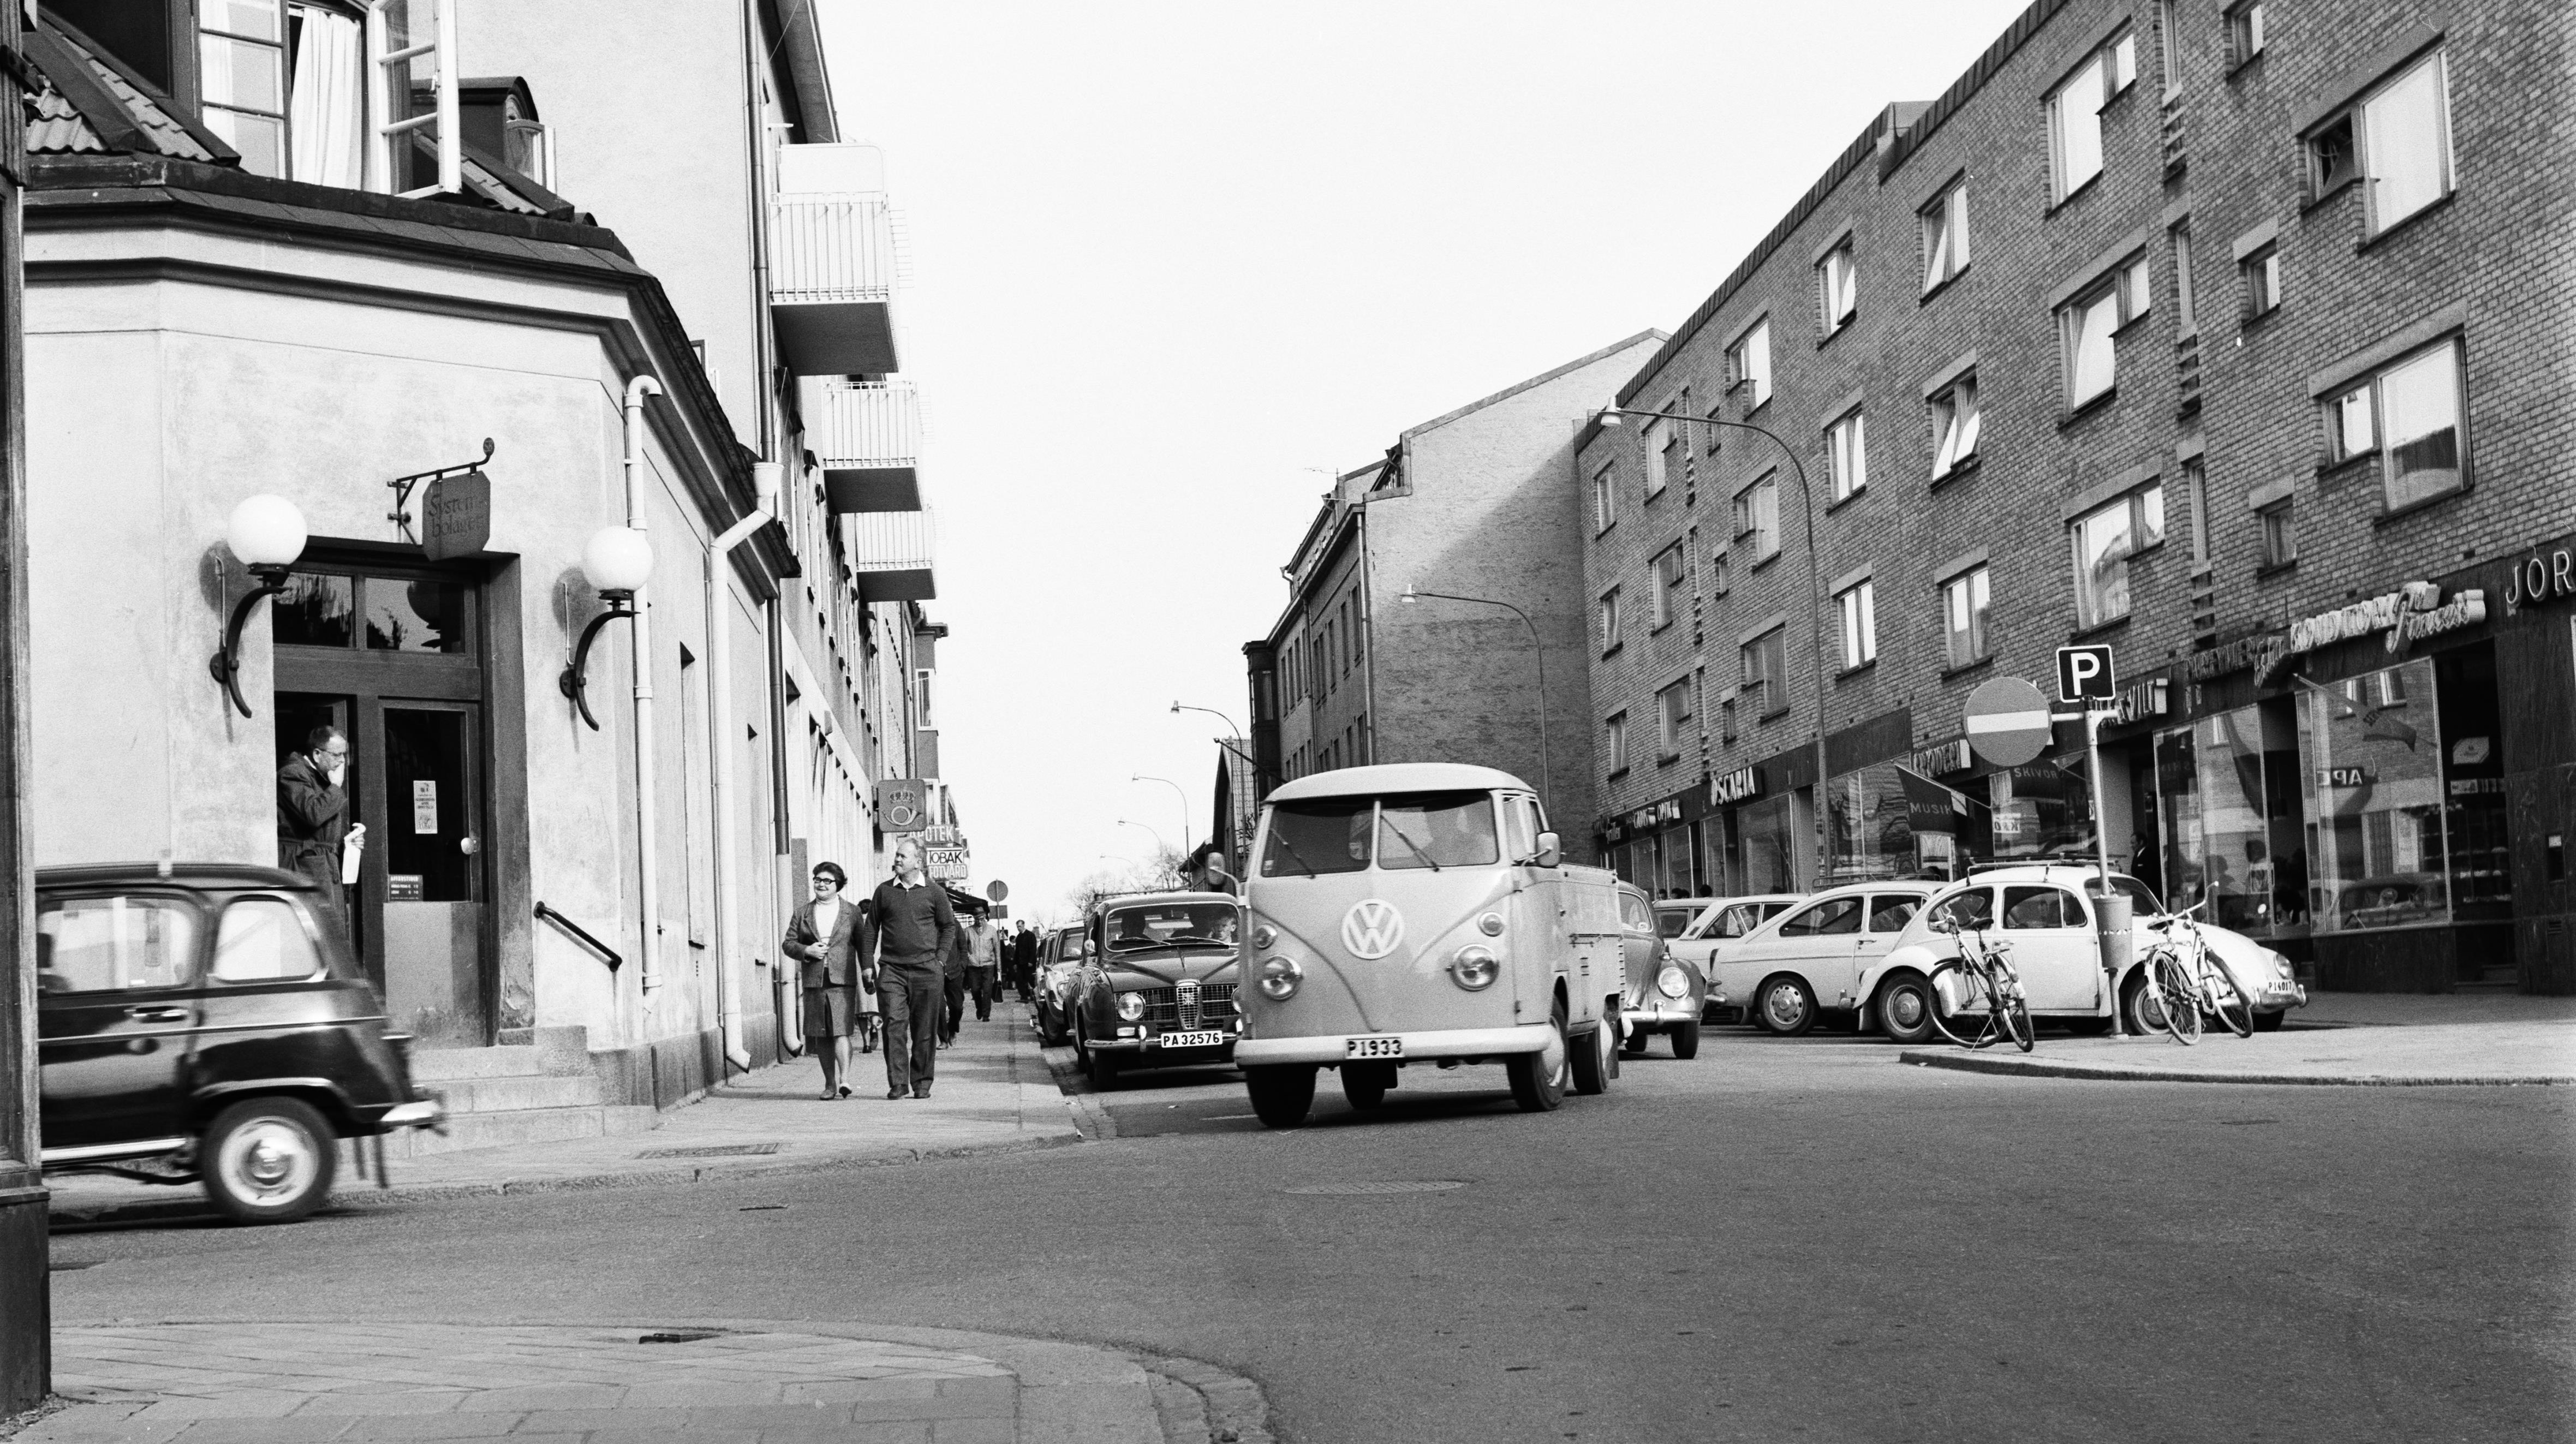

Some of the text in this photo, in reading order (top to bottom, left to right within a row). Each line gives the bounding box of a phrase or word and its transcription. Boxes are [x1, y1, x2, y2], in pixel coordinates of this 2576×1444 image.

[2071, 652, 2100, 696] P
[2013, 767, 2059, 779] SKIVOR
[1710, 766, 1756, 807] OSCARIA
[1910, 802, 1953, 816] MUSIK
[928, 850, 963, 864] TOBAK
[929, 863, 967, 879] FOTVÅRD
[1347, 1039, 1402, 1057] P1933
